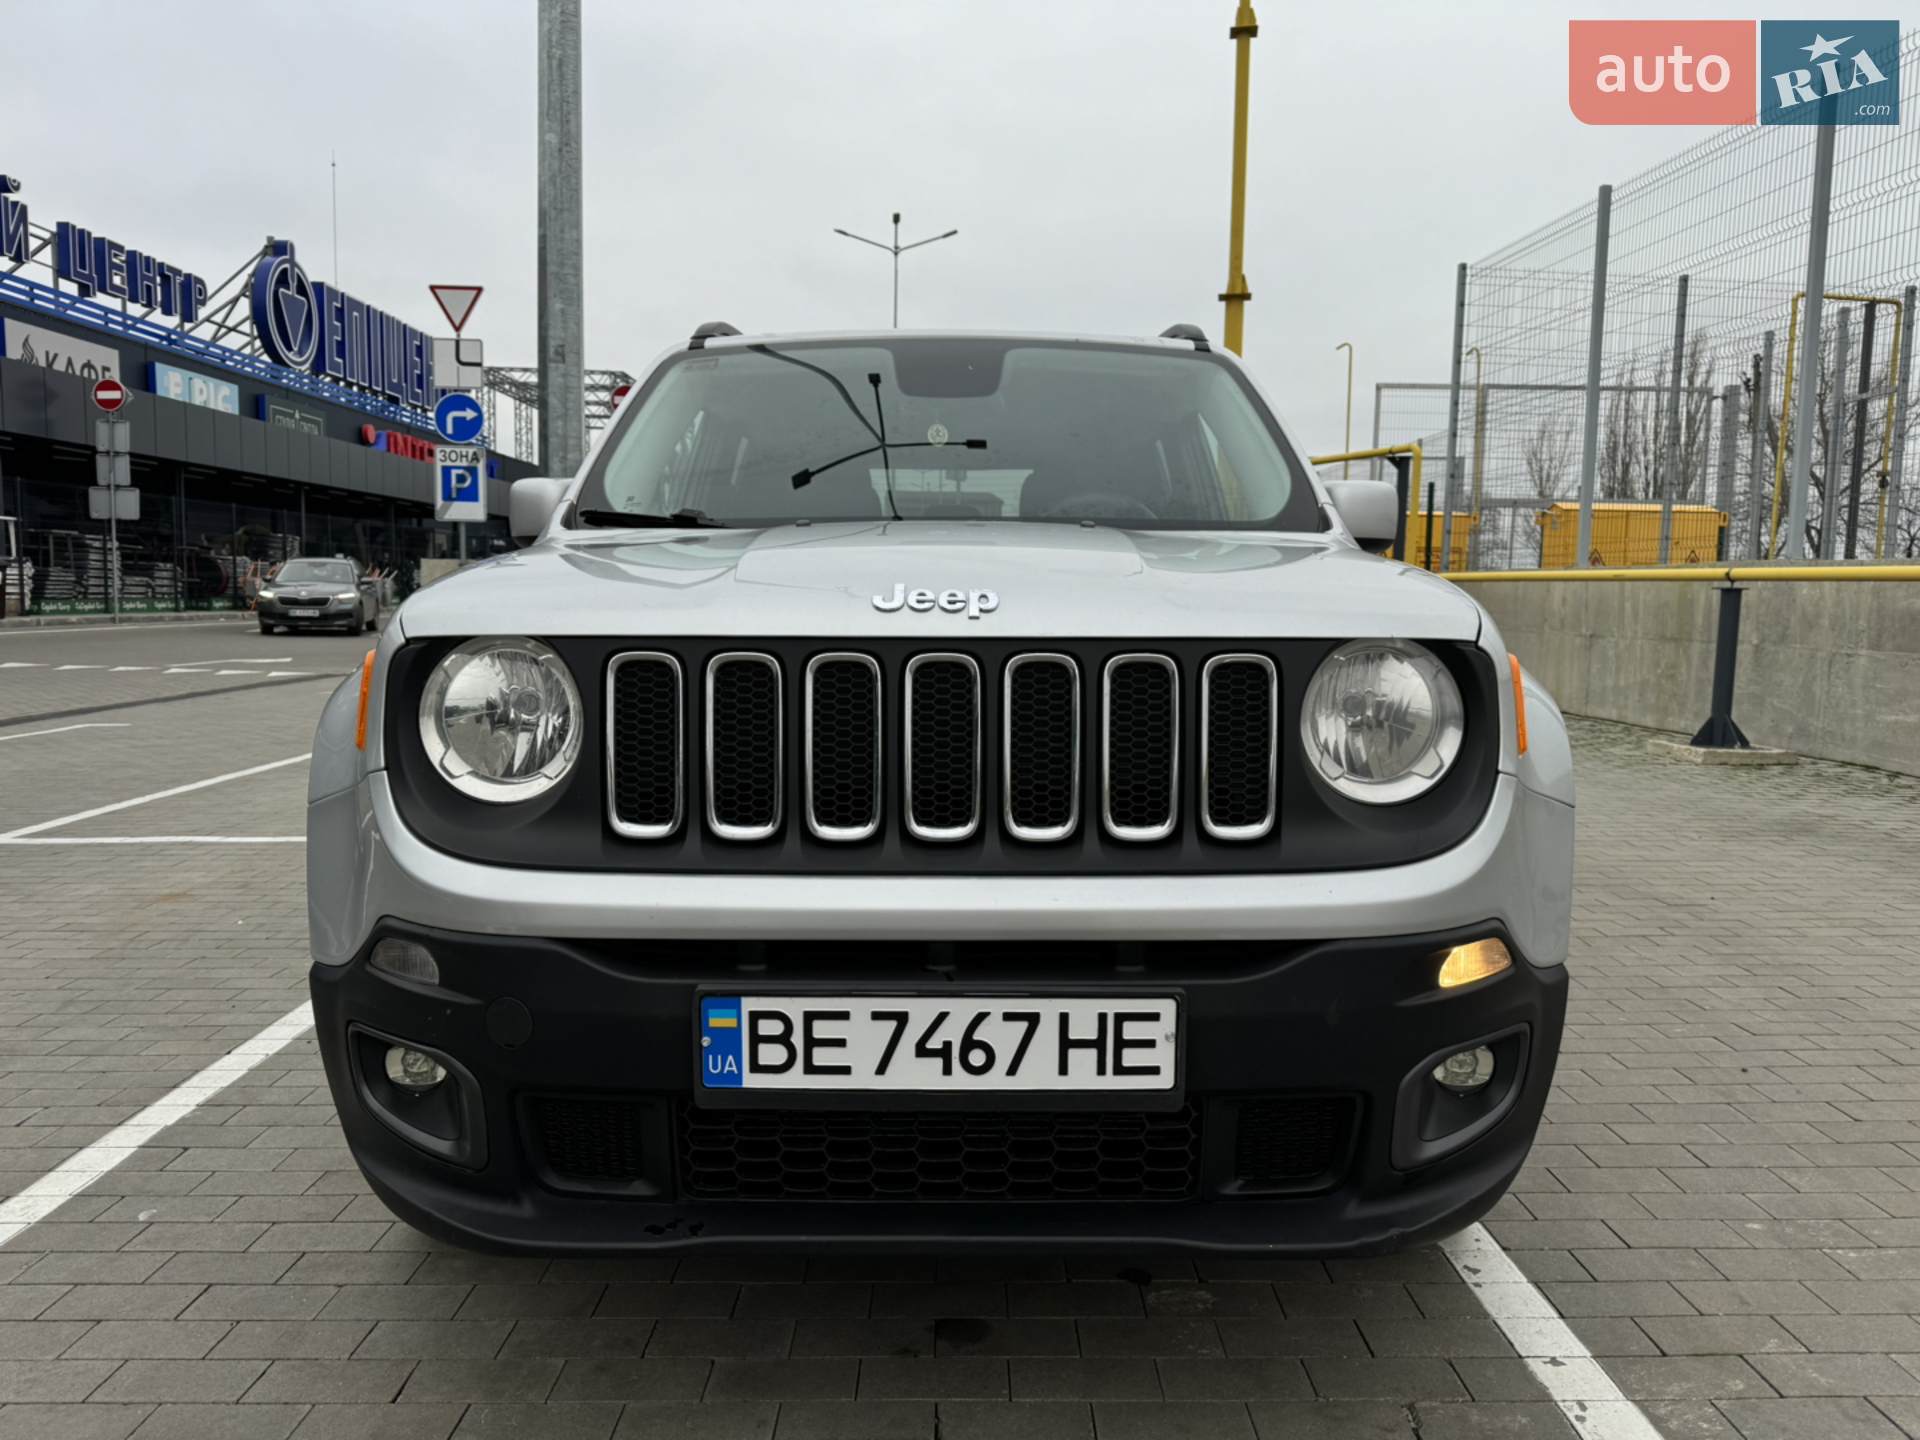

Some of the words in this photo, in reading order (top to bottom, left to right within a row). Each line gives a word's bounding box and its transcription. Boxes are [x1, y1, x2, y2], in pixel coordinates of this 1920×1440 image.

[56, 221, 207, 325] ЦЕНТР
[438, 449, 481, 463] ЗОНА
[450, 468, 472, 499] P
[871, 583, 1000, 620] Jeep
[747, 1009, 853, 1076] BE
[869, 1010, 1042, 1077] 7467
[1057, 1011, 1162, 1077] HE
[707, 1054, 739, 1075] UA
